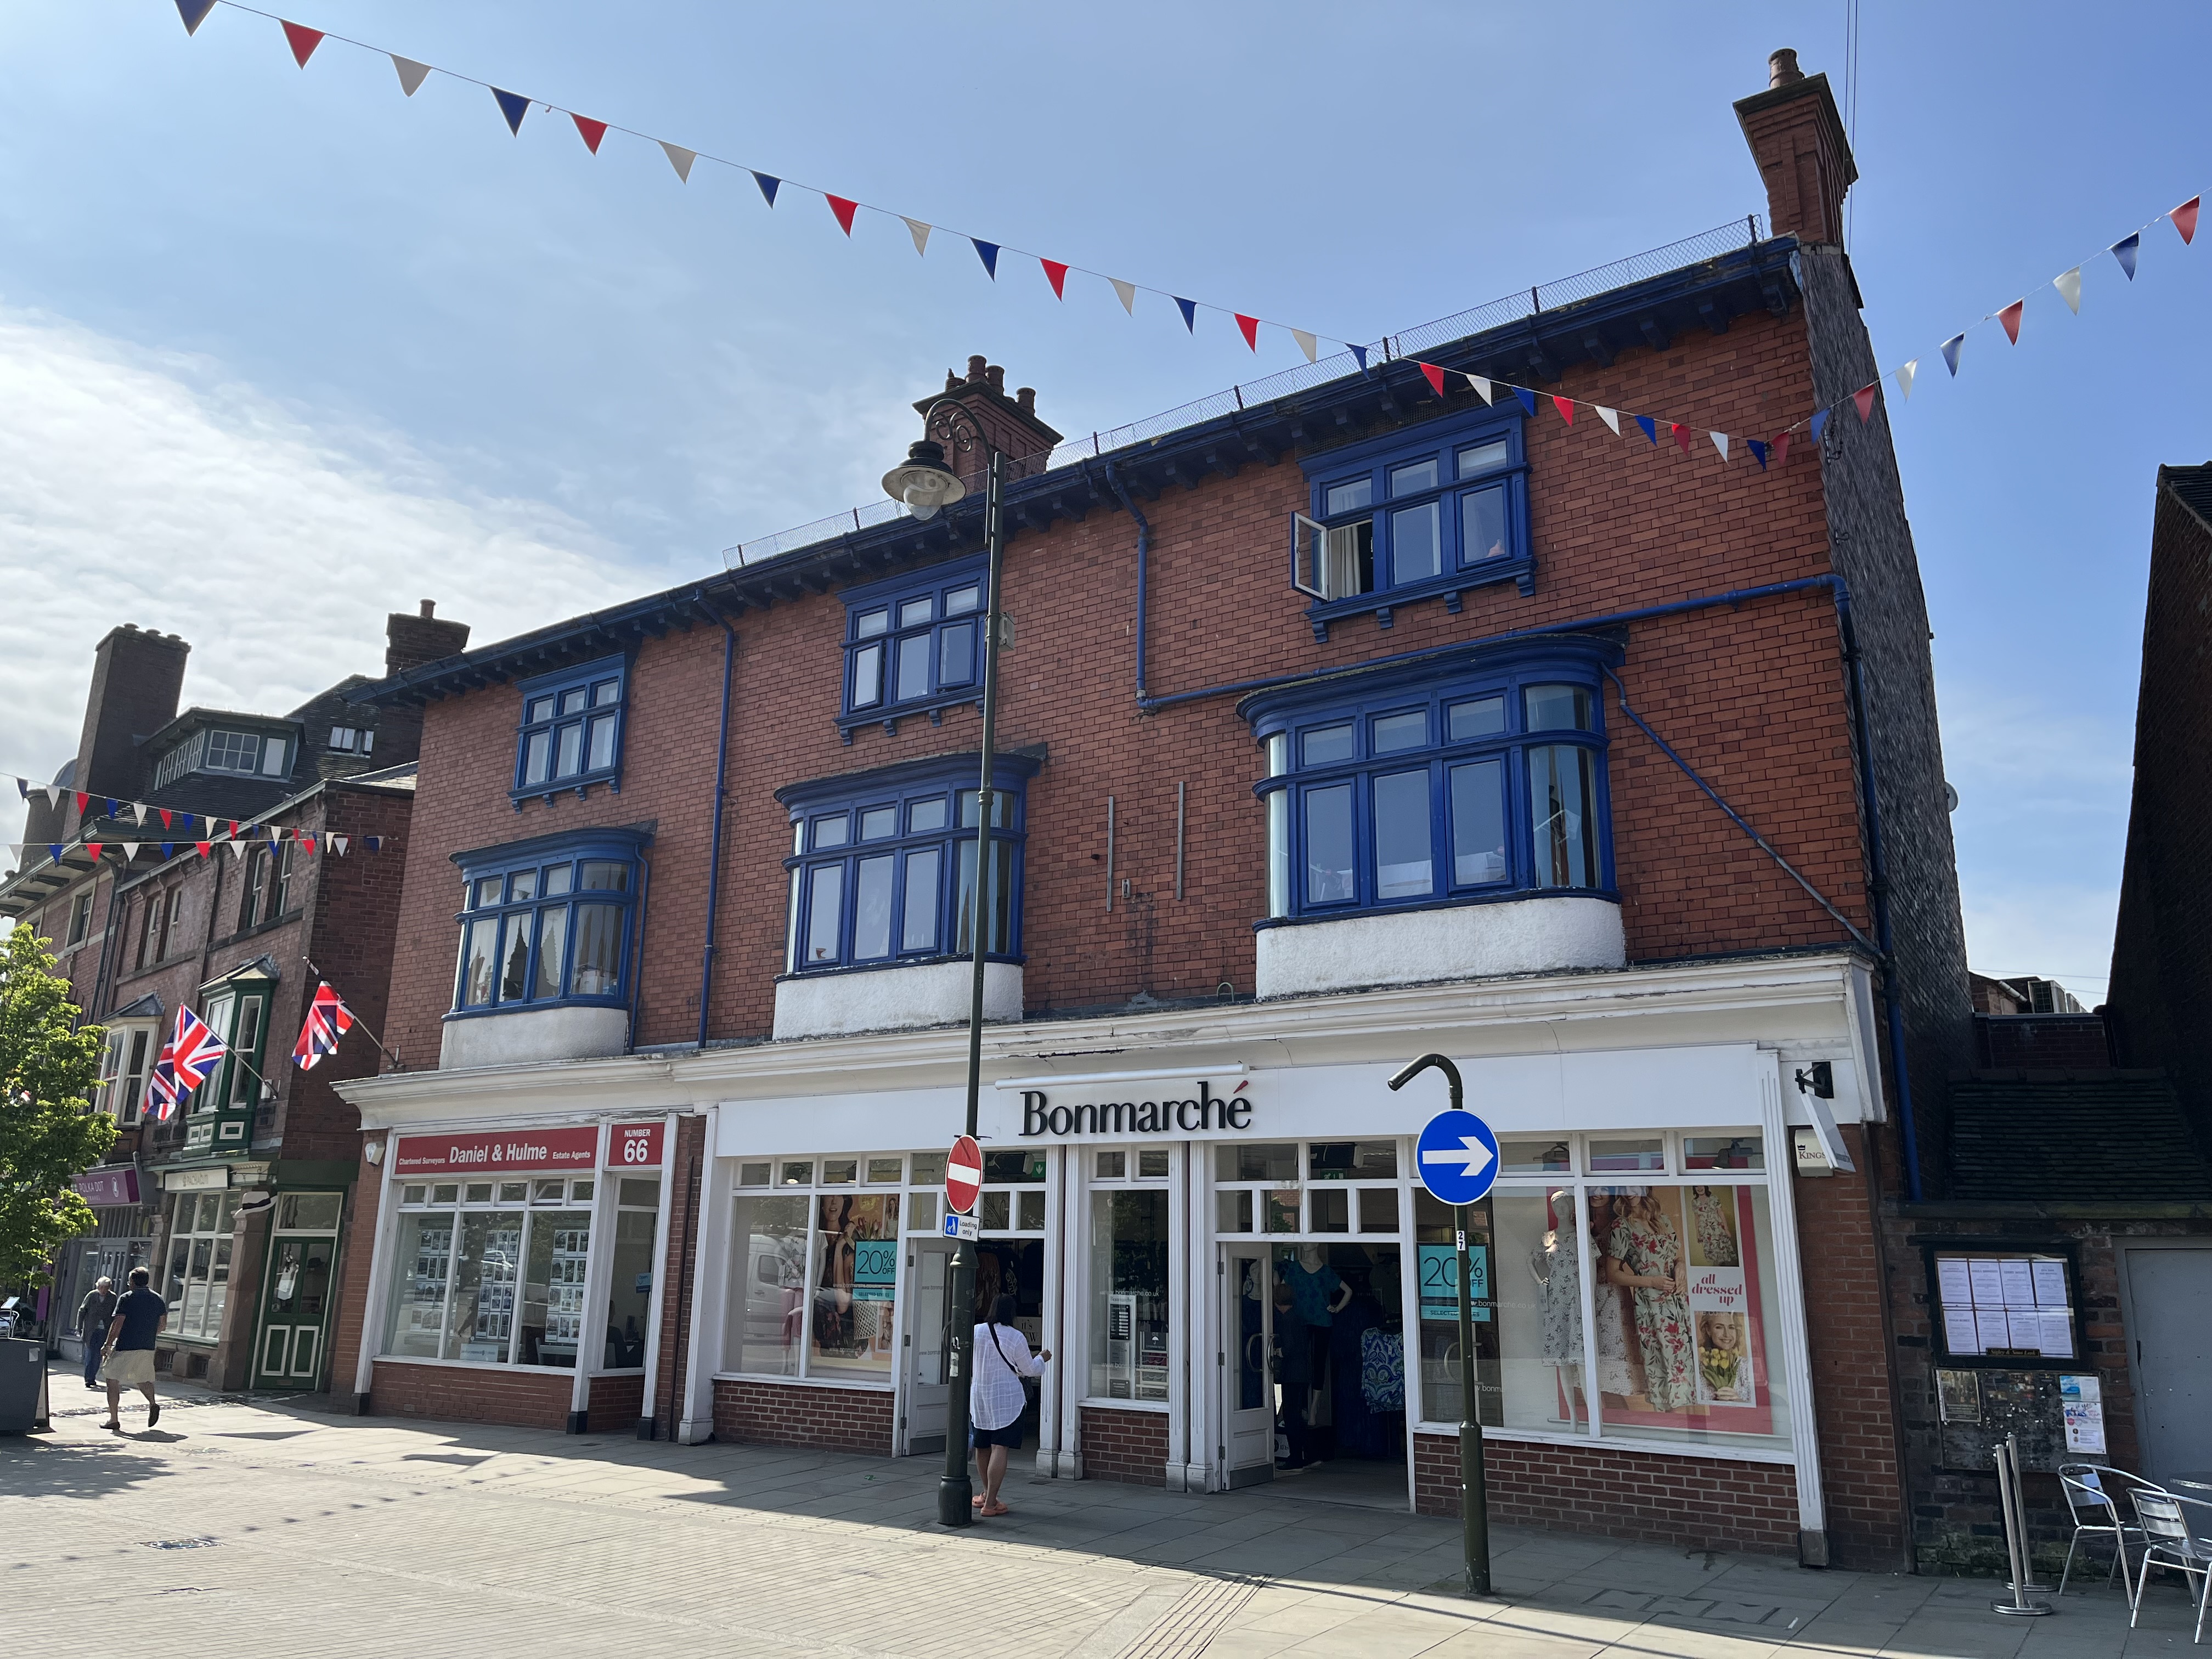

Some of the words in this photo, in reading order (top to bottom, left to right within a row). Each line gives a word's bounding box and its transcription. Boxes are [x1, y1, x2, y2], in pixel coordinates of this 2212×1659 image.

[1018, 1080, 1251, 1136] Bonmarché
[624, 1129, 651, 1137] NUMBER
[399, 1157, 421, 1165] Chartered
[422, 1157, 445, 1165] Surveyors
[449, 1145, 488, 1164] Daniel
[492, 1144, 502, 1162] &
[506, 1143, 548, 1161] Hulme
[552, 1151, 570, 1159] Estate
[571, 1150, 590, 1160] Agents
[624, 1139, 648, 1163] 66
[78, 1182, 95, 1193] POLKA
[94, 1181, 104, 1192] DOT
[960, 1220, 977, 1229] Loading
[857, 1250, 895, 1274] 20%
[1701, 1274, 1715, 1284] all
[1692, 1283, 1742, 1295] dressed
[1470, 1300, 1536, 1309] w.bonmarche.co.uk
[1719, 1296, 1734, 1306] up
